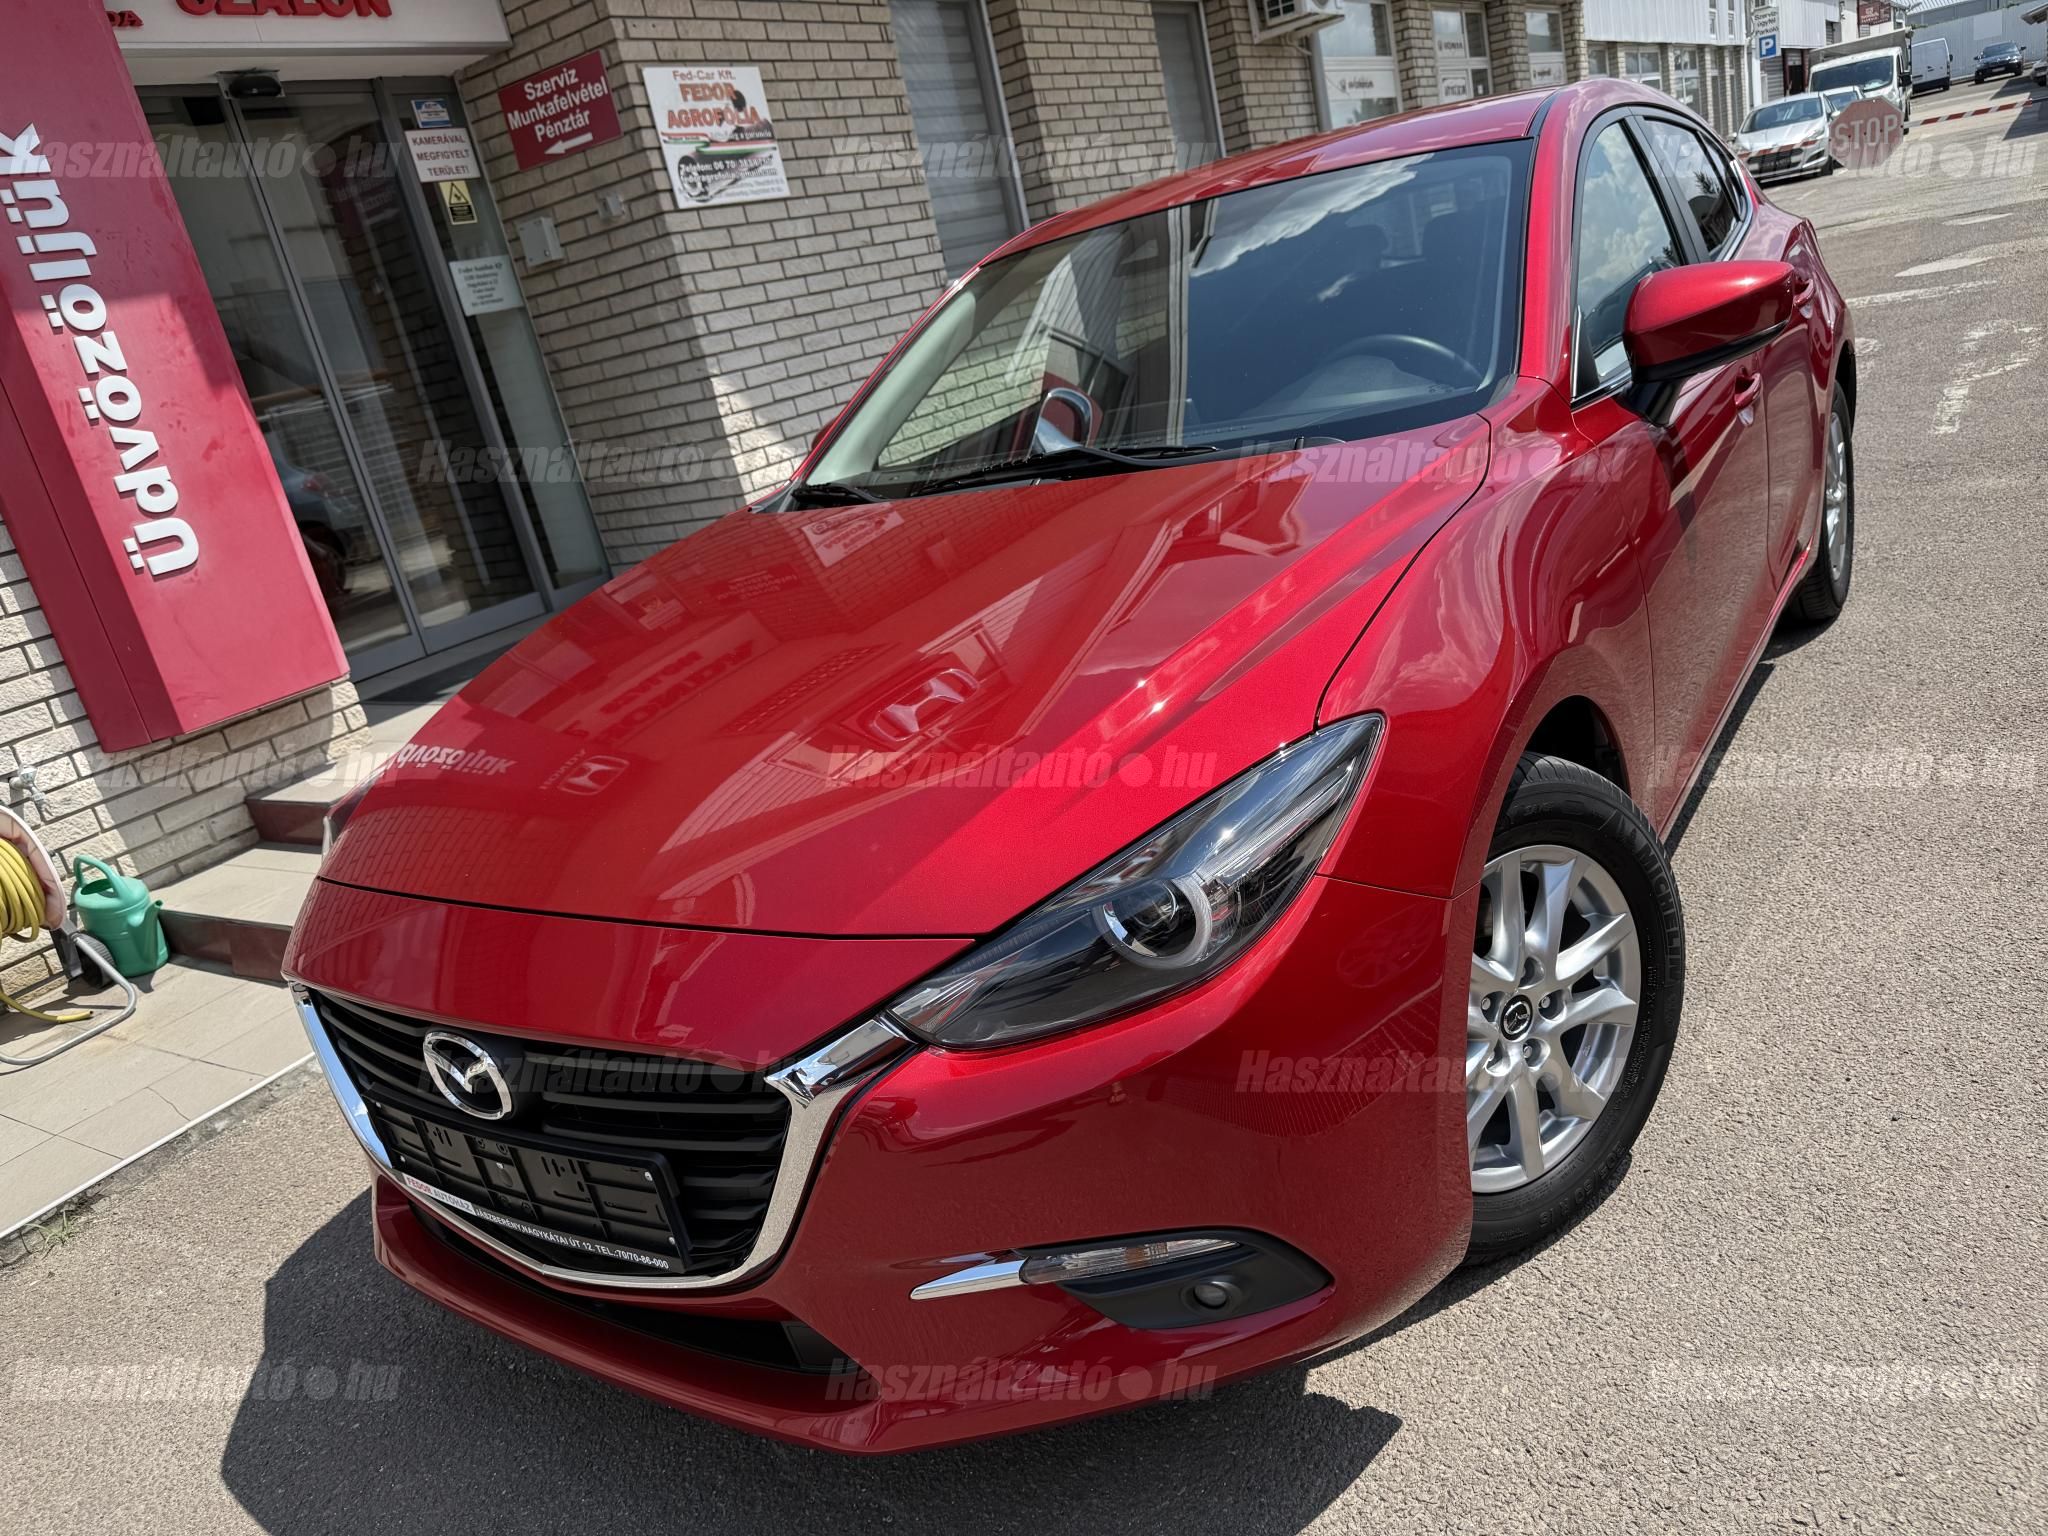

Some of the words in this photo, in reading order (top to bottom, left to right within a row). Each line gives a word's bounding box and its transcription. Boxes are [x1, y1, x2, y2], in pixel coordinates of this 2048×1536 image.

[1761, 38, 1774, 56] P
[524, 67, 579, 101] Szerviz
[672, 70, 715, 80] Fed-Car
[717, 70, 736, 80] Kft.
[679, 82, 737, 101] FEDOR
[507, 76, 608, 131] Munkafelvétel
[667, 103, 761, 128] AGROFÓLIA
[534, 109, 590, 142] Pénztár
[1834, 114, 1898, 150] STOP
[411, 133, 466, 146] KAMERÁVAL
[416, 149, 470, 162] MEGFIGYELT
[426, 165, 470, 177] TERÜLET!
[0, 122, 200, 576] Üdvözöljük
[406, 1177, 432, 1193] FEDOR
